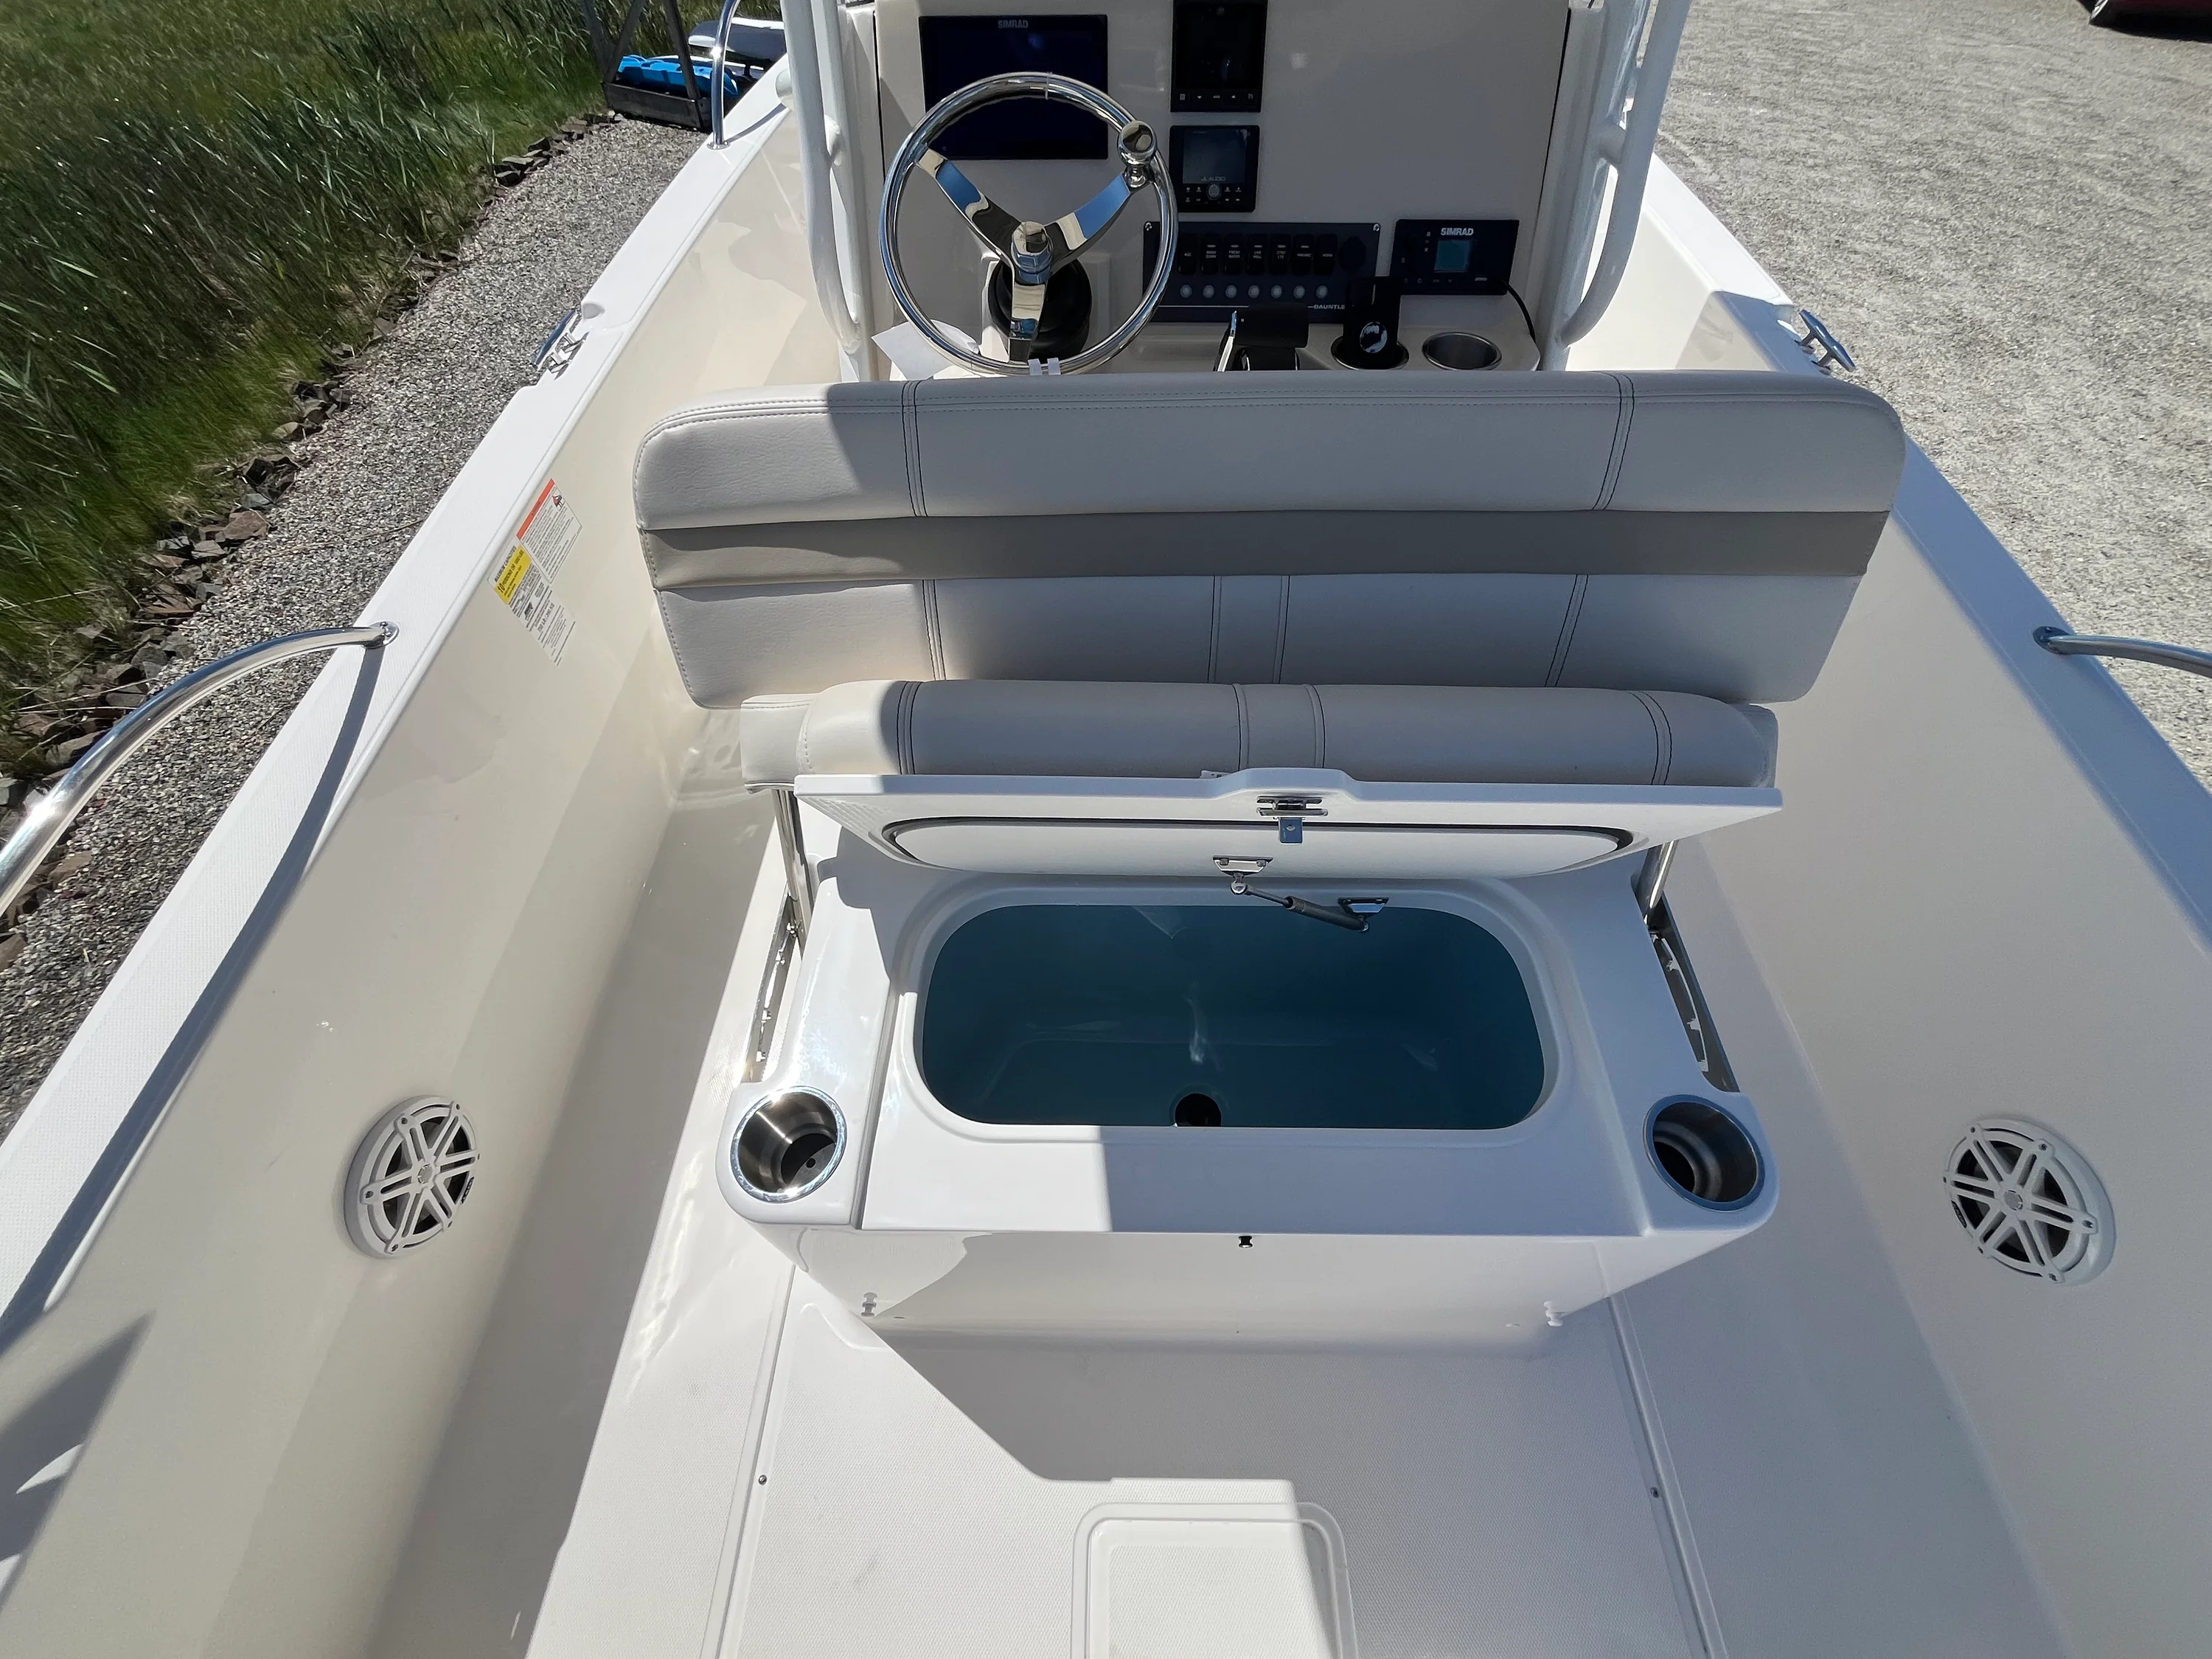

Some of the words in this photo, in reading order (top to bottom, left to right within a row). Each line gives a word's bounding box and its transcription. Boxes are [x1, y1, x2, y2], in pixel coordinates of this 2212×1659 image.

[998, 19, 1029, 29] SIMRAD
[1441, 228, 1474, 236] SIMRAD
[497, 582, 505, 593] 10
